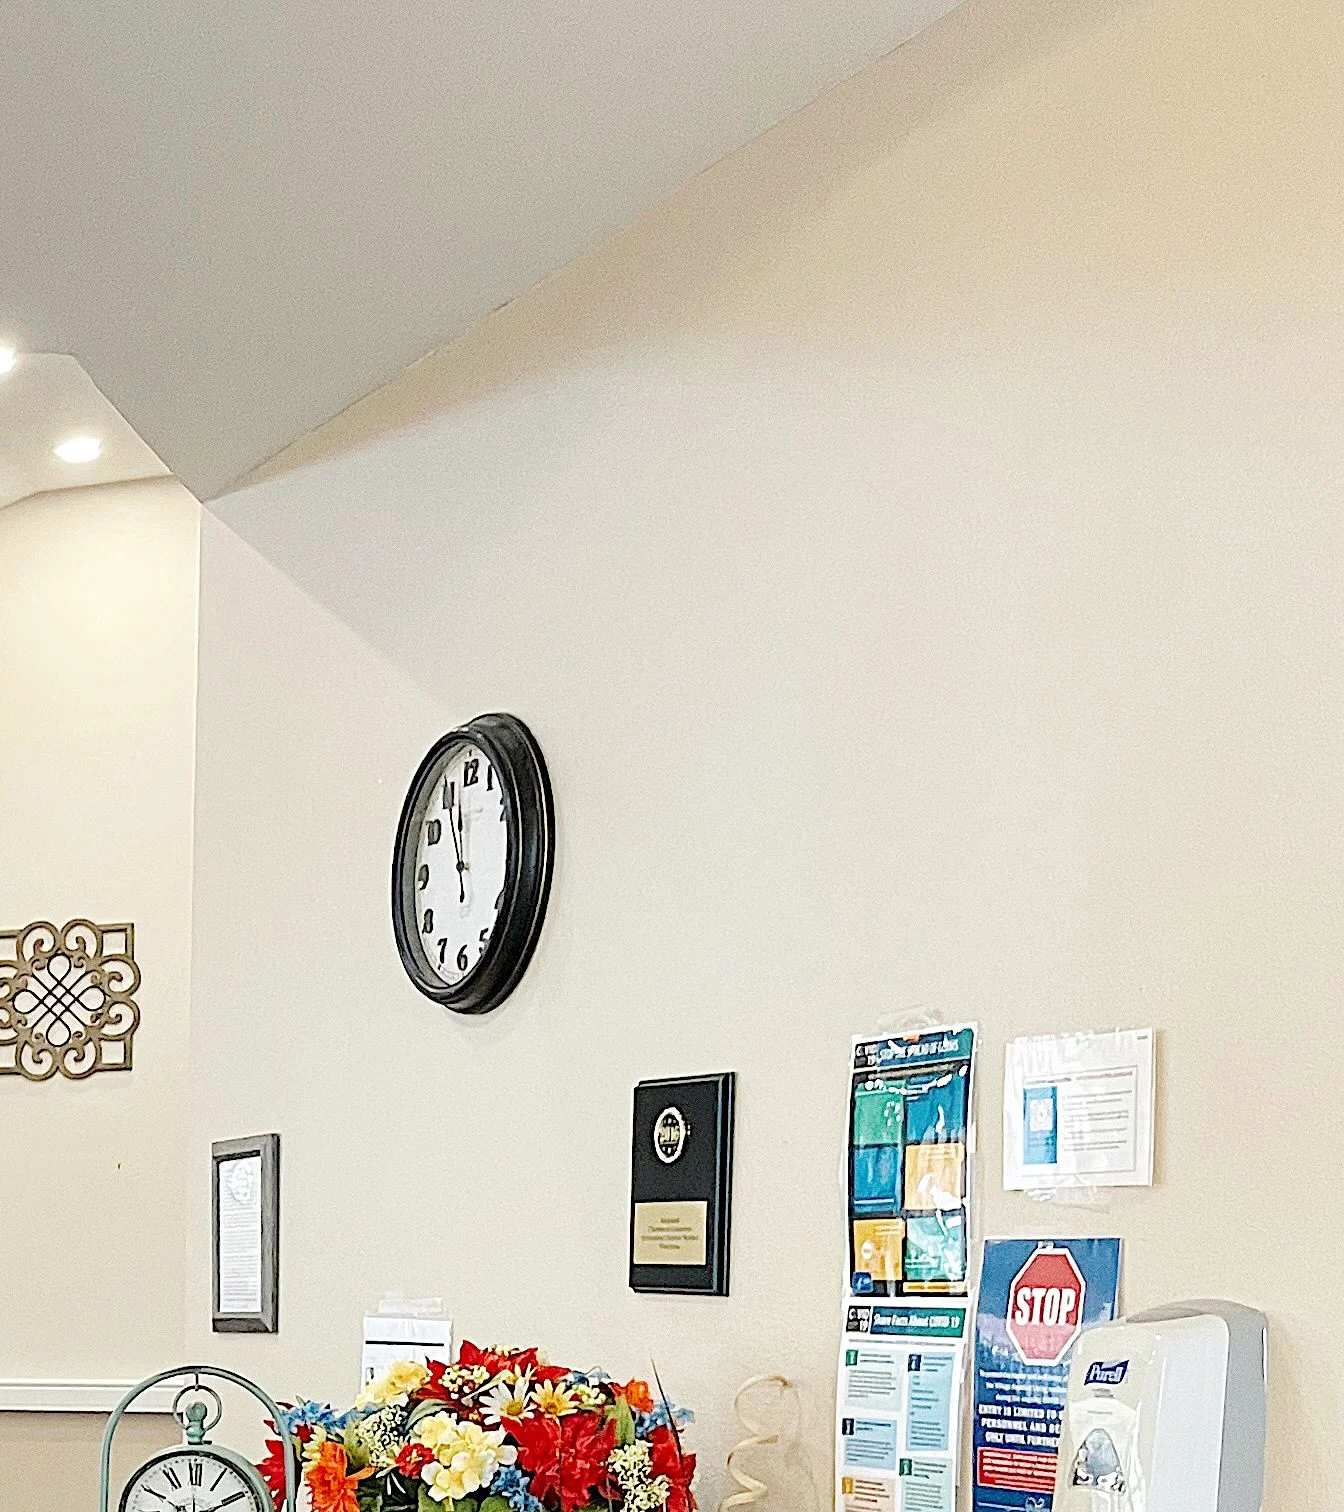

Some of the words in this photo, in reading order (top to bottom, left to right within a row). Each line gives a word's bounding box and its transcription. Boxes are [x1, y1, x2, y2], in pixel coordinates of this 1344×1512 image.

[463, 759, 479, 787] 12
[486, 764, 493, 791] 1
[422, 908, 434, 933] 8
[437, 937, 447, 970] 7
[457, 944, 468, 971] 6
[1015, 1287, 1076, 1327] STOP
